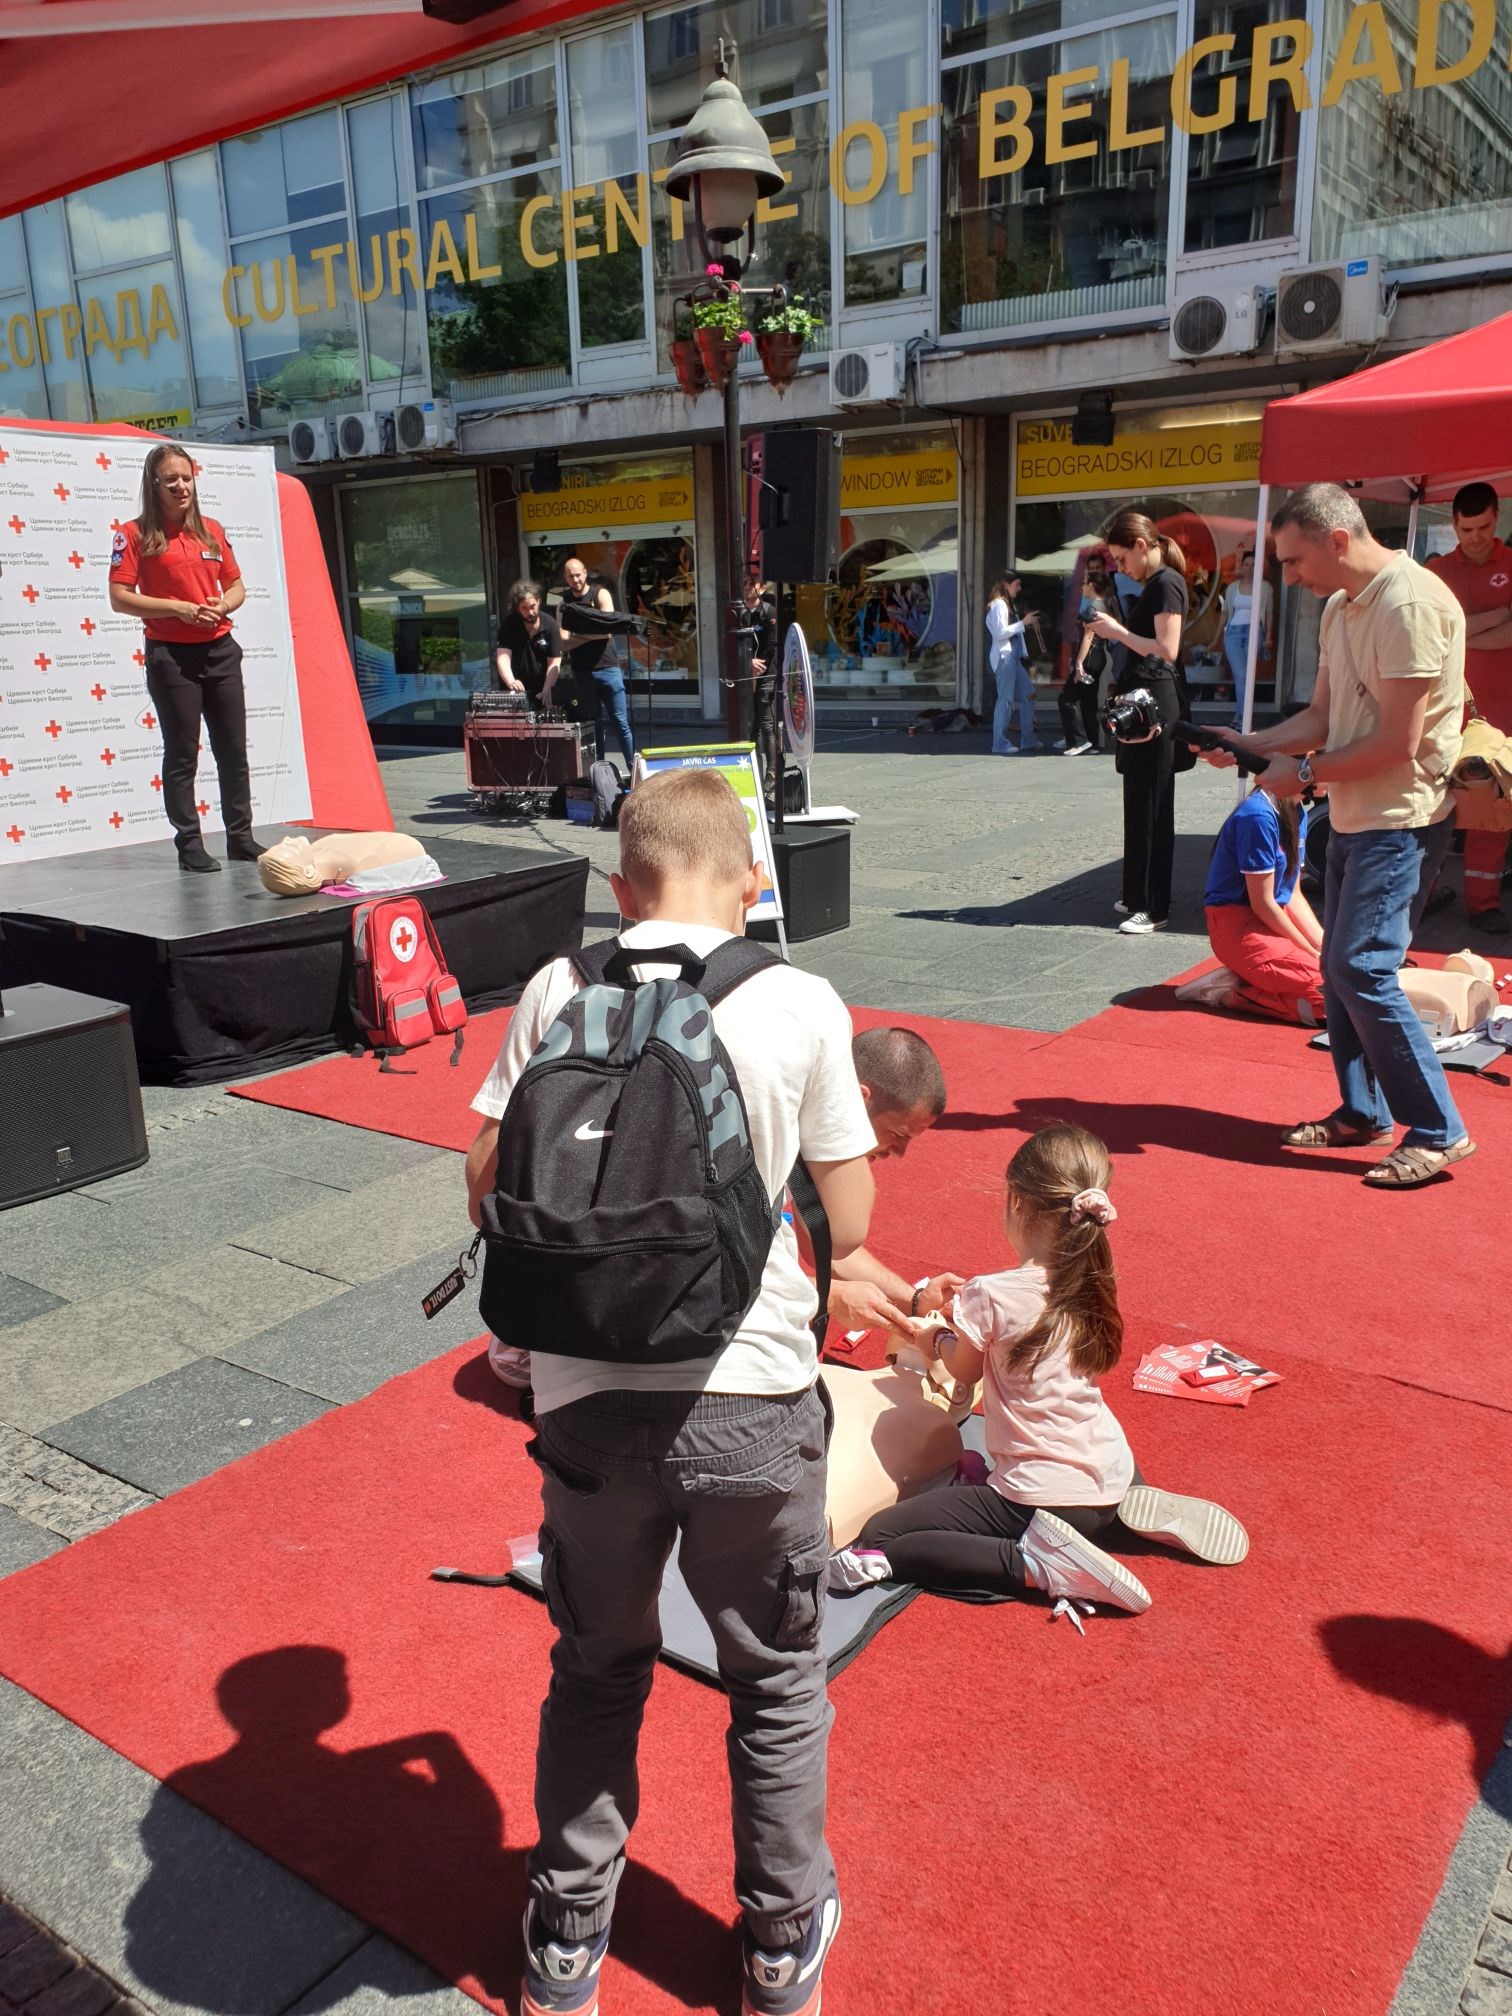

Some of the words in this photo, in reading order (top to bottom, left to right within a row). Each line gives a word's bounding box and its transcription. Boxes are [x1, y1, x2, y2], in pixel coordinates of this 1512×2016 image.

[222, 213, 502, 328] CULTURAL
[519, 137, 799, 268] CENTE
[830, 103, 943, 206] OF
[978, 0, 1512, 179] BELGRAD
[1021, 450, 1152, 478] BEOGRADSKI
[1160, 444, 1222, 468] IZLOG
[840, 470, 911, 492] WINDOW
[527, 499, 605, 519] BEOGRADSKI
[608, 494, 646, 512] IZLOG
